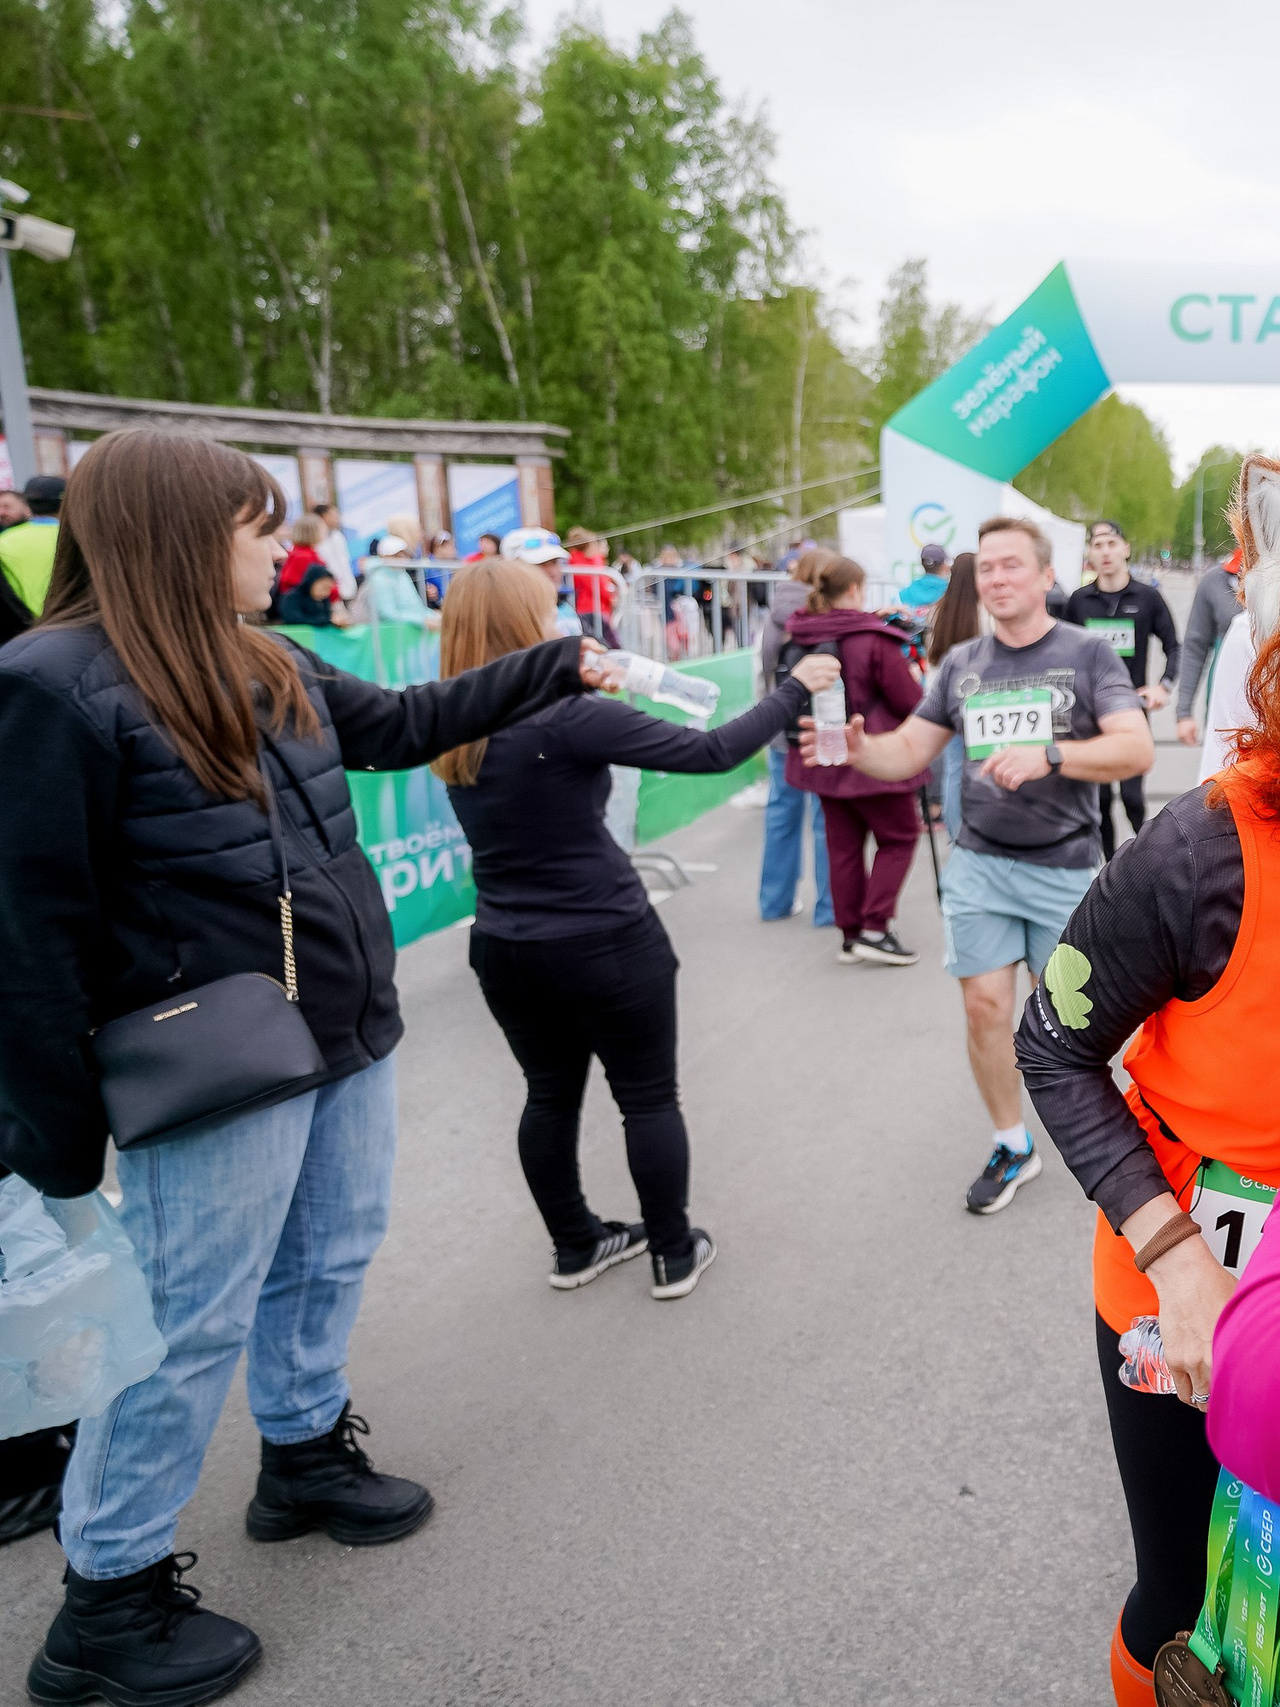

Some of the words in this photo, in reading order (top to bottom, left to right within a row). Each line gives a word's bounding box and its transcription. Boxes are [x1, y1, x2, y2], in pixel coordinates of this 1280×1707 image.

[967, 347, 1063, 438] марафон
[977, 710, 1040, 738] 1379
[1215, 1210, 1264, 1268] 1
[1261, 1509, 1274, 1554] СБЕР
[1258, 1591, 1268, 1622] лет
[1255, 1622, 1265, 1650] 185
